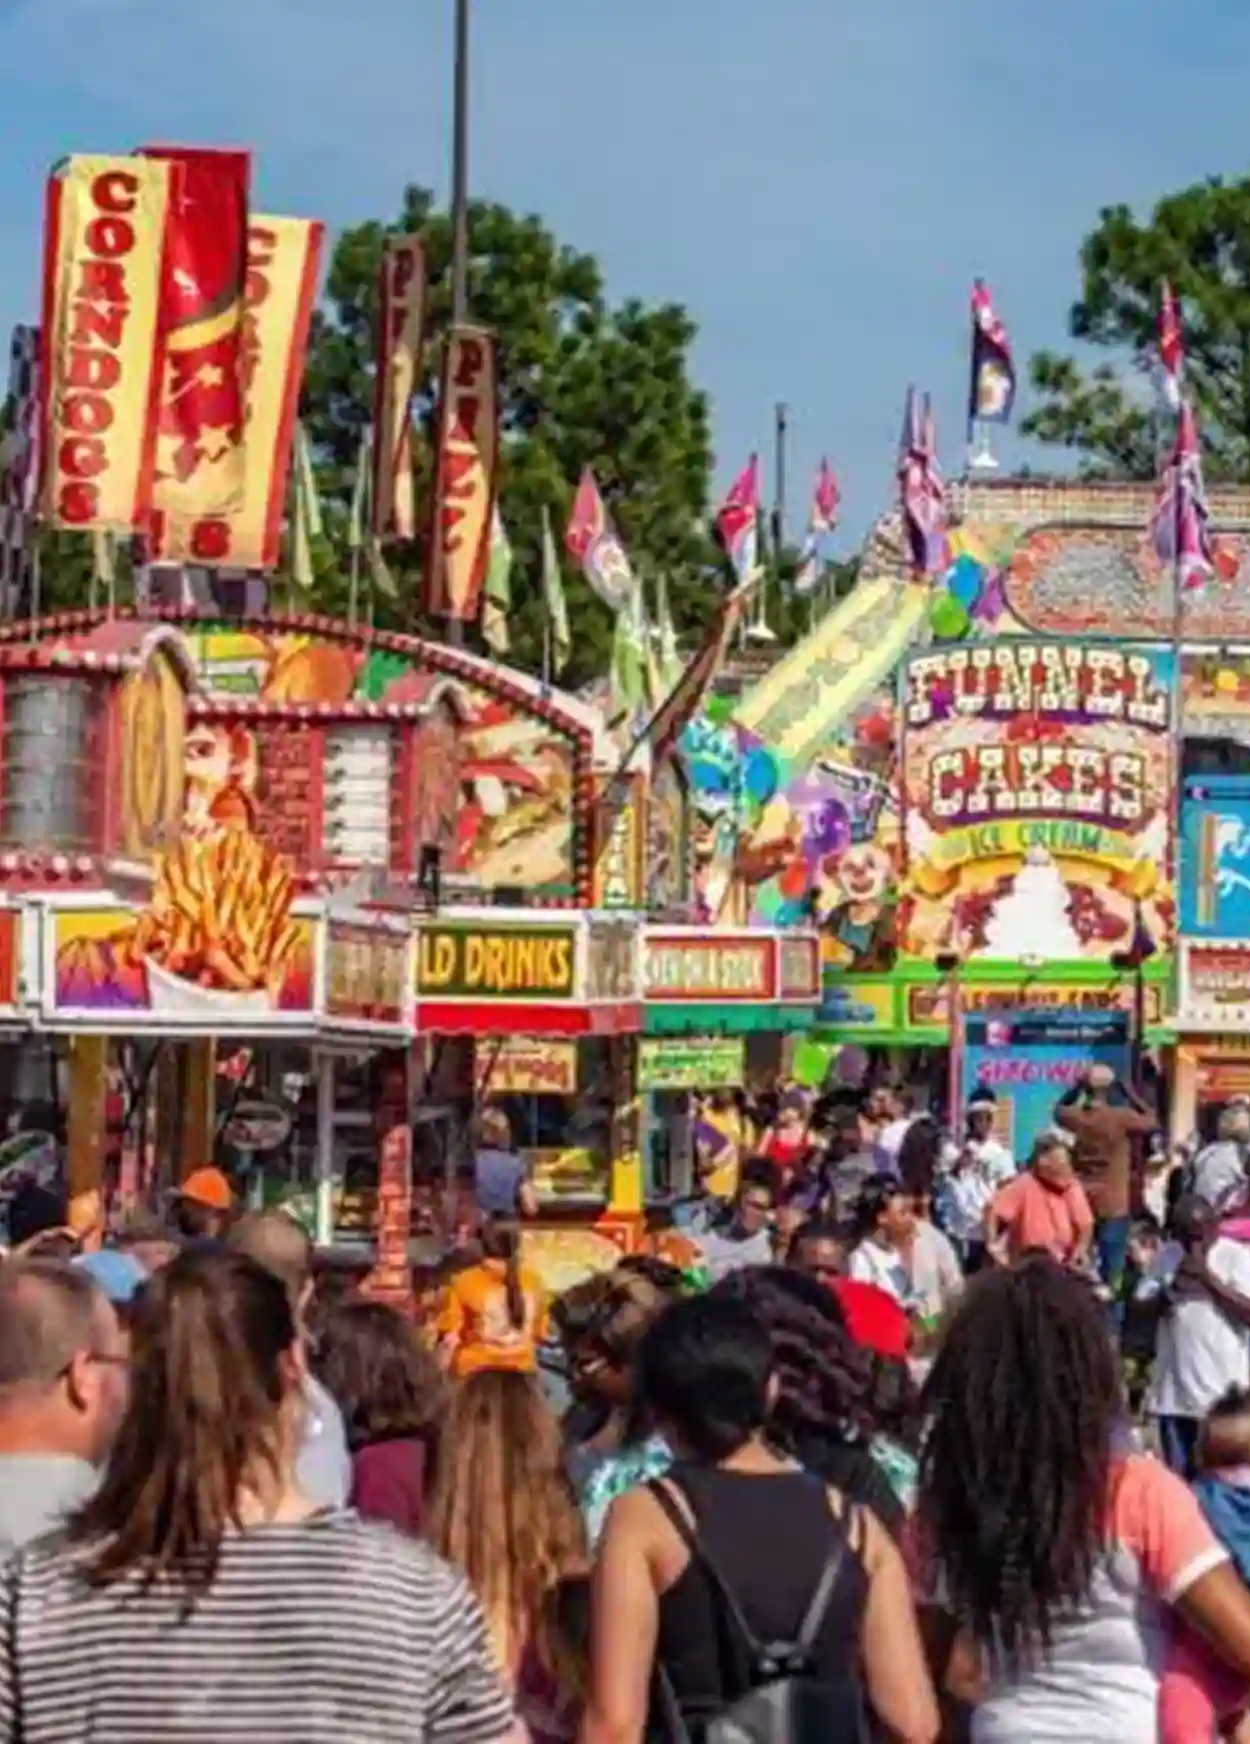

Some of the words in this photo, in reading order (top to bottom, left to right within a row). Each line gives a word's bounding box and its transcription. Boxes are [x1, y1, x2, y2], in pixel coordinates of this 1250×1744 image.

[59, 170, 139, 524] CORNDOGS
[906, 645, 1167, 726] FUNNEL
[931, 746, 1143, 820] CAKES
[465, 935, 571, 991] DRINKS
